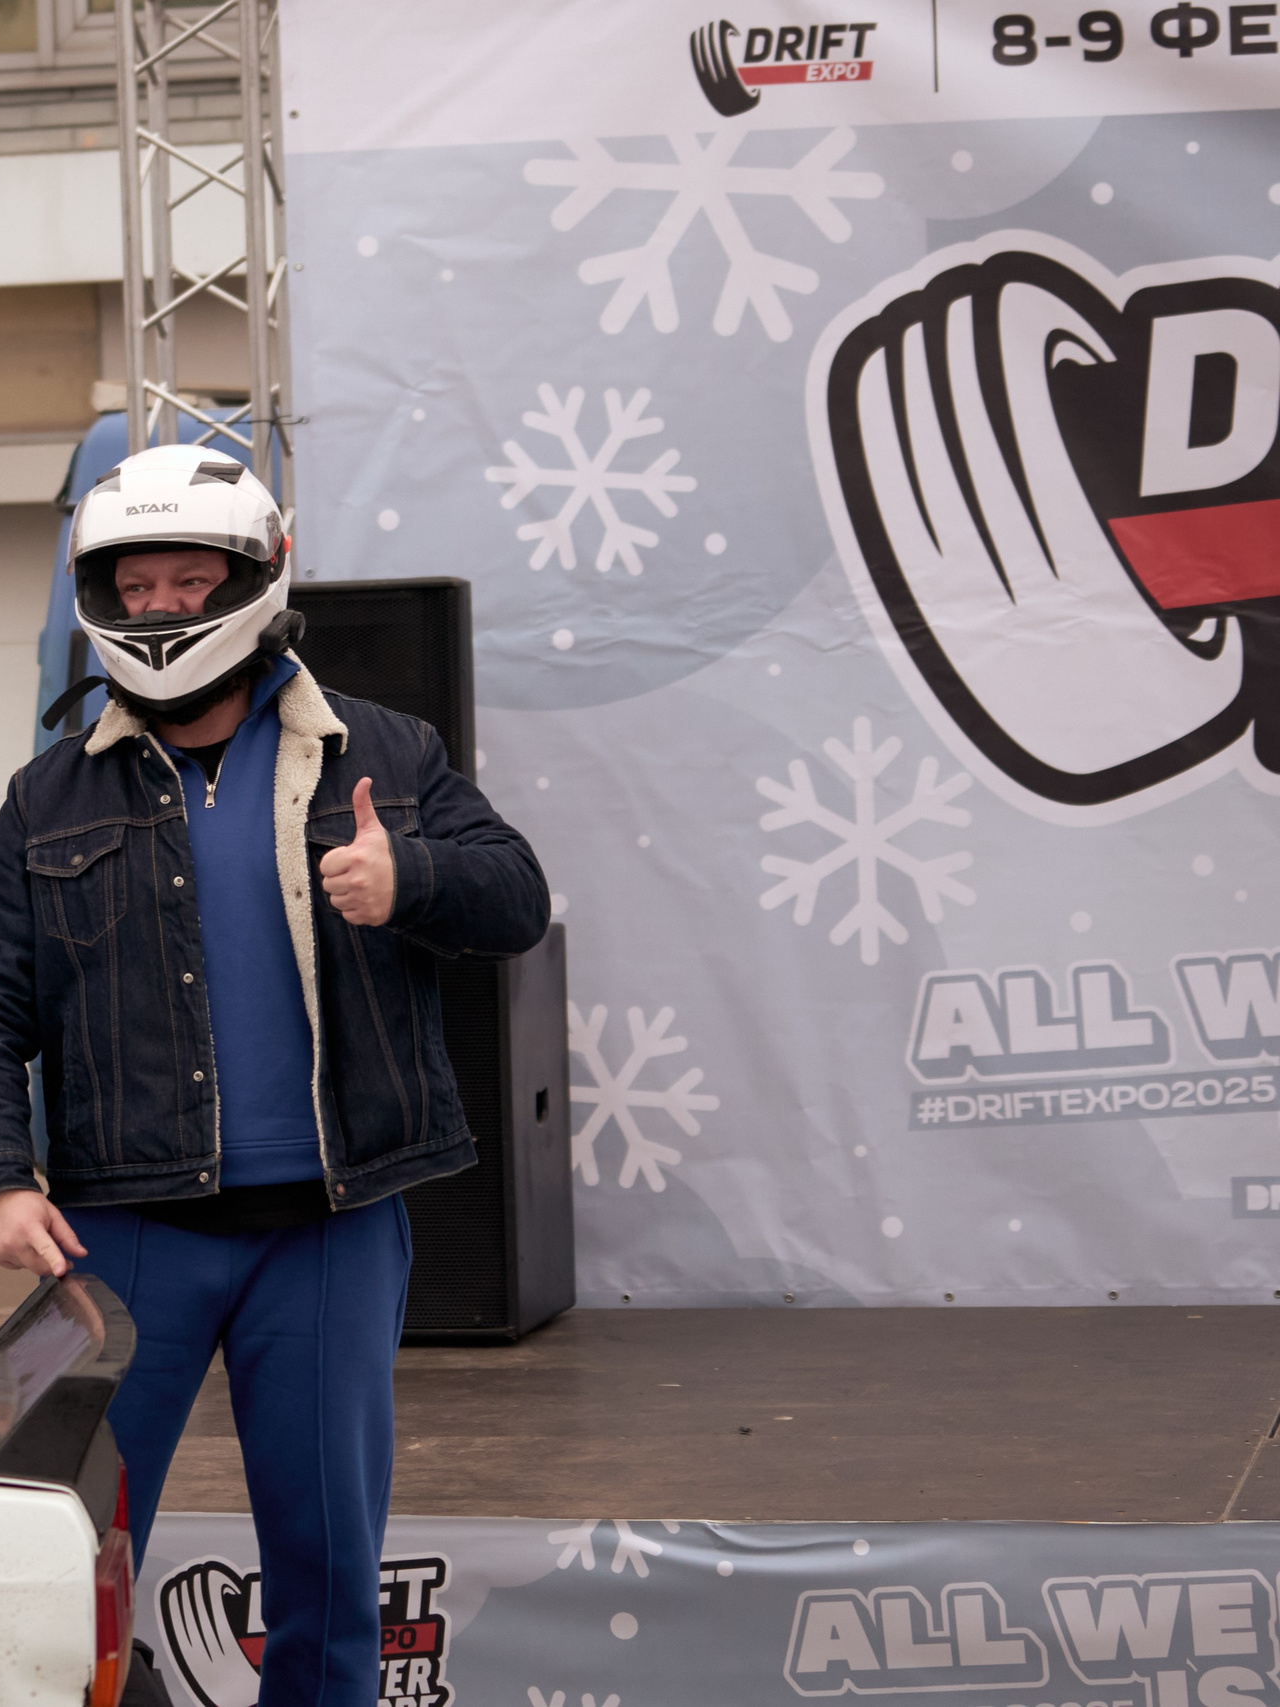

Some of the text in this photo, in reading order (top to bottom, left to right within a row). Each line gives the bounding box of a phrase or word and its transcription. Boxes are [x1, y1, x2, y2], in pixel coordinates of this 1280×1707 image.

[742, 22, 877, 64] DRIFT
[991, 10, 1124, 67] 8-9
[805, 62, 861, 82] EXPO
[125, 503, 179, 517] ATAKI
[914, 966, 1160, 1072] ALL
[917, 1076, 1278, 1124] #DRIFTEXPO2025
[380, 1626, 417, 1652] PO
[792, 1580, 1262, 1678] ALL WE
